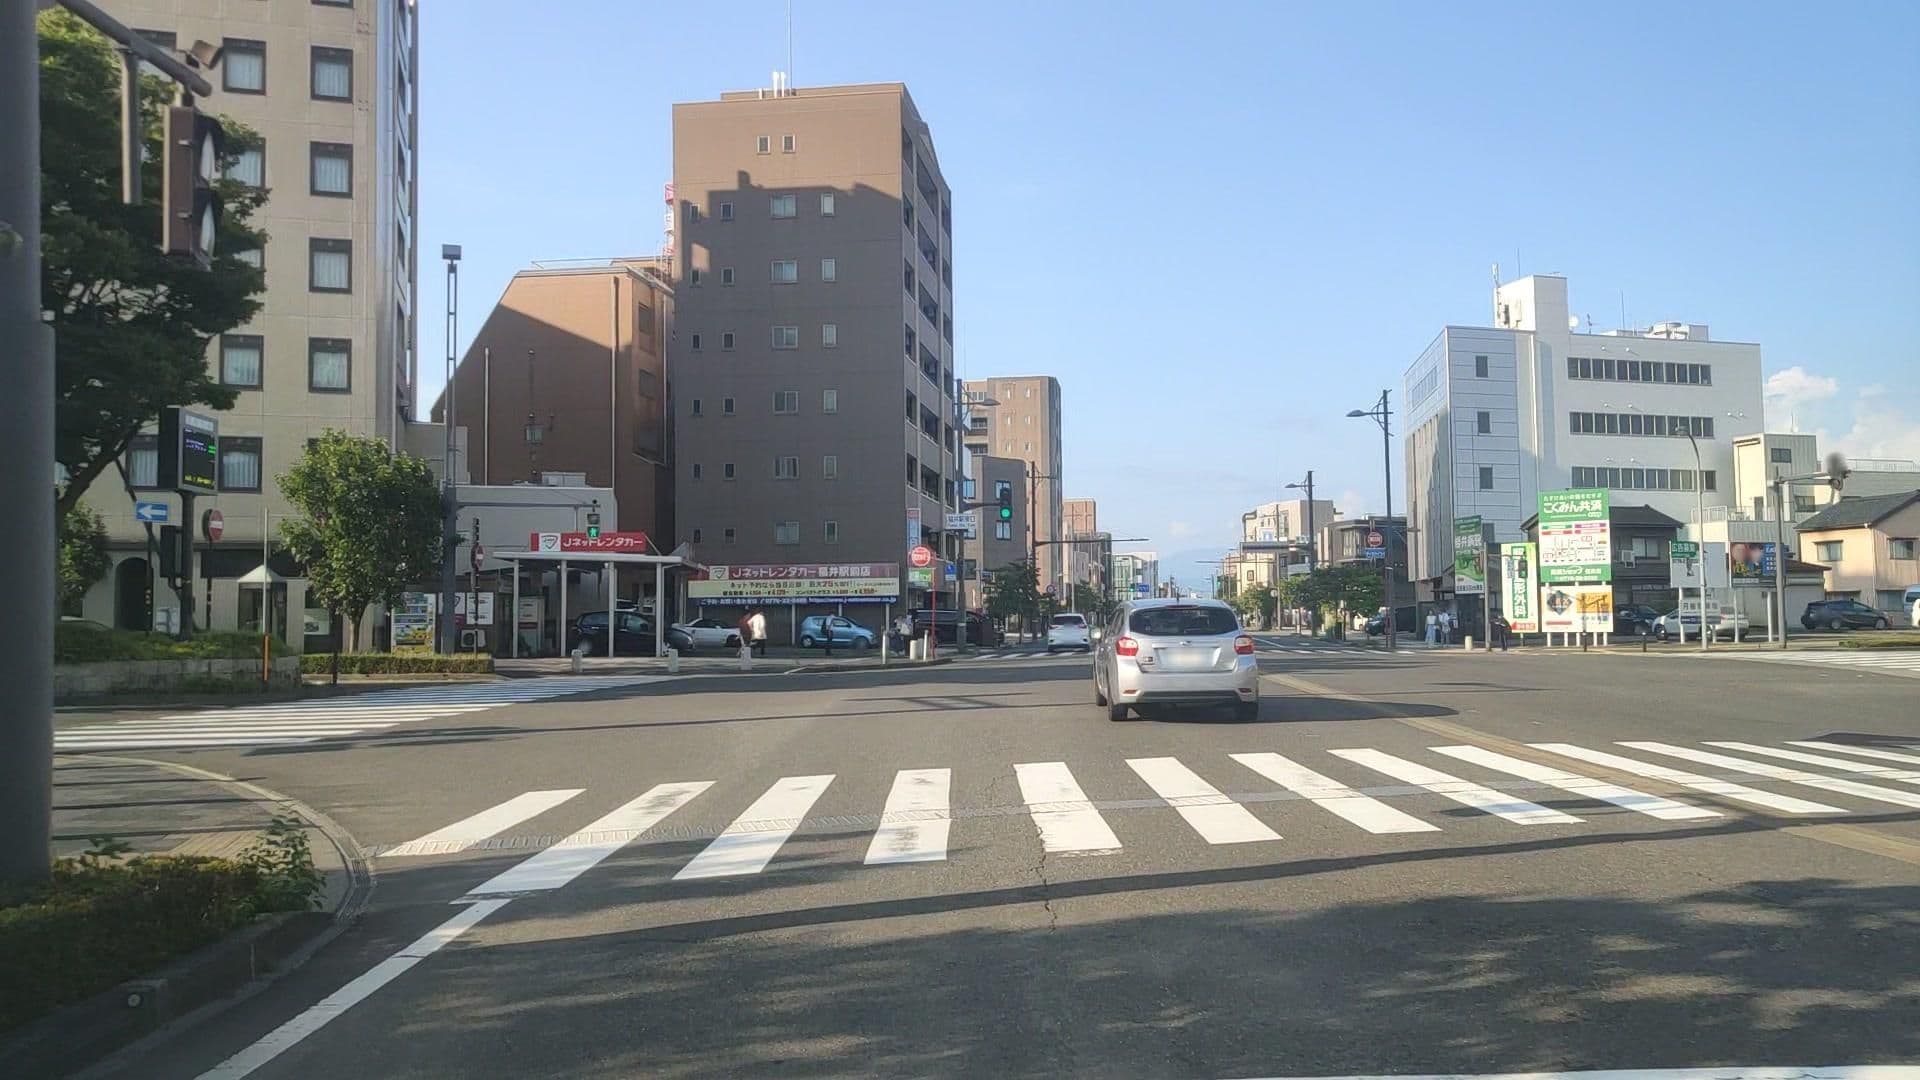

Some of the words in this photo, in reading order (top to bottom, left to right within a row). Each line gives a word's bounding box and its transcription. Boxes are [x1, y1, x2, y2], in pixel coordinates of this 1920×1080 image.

[1543, 500, 1602, 514] こくみん共済
[563, 537, 643, 547] Jネットレンタカー
